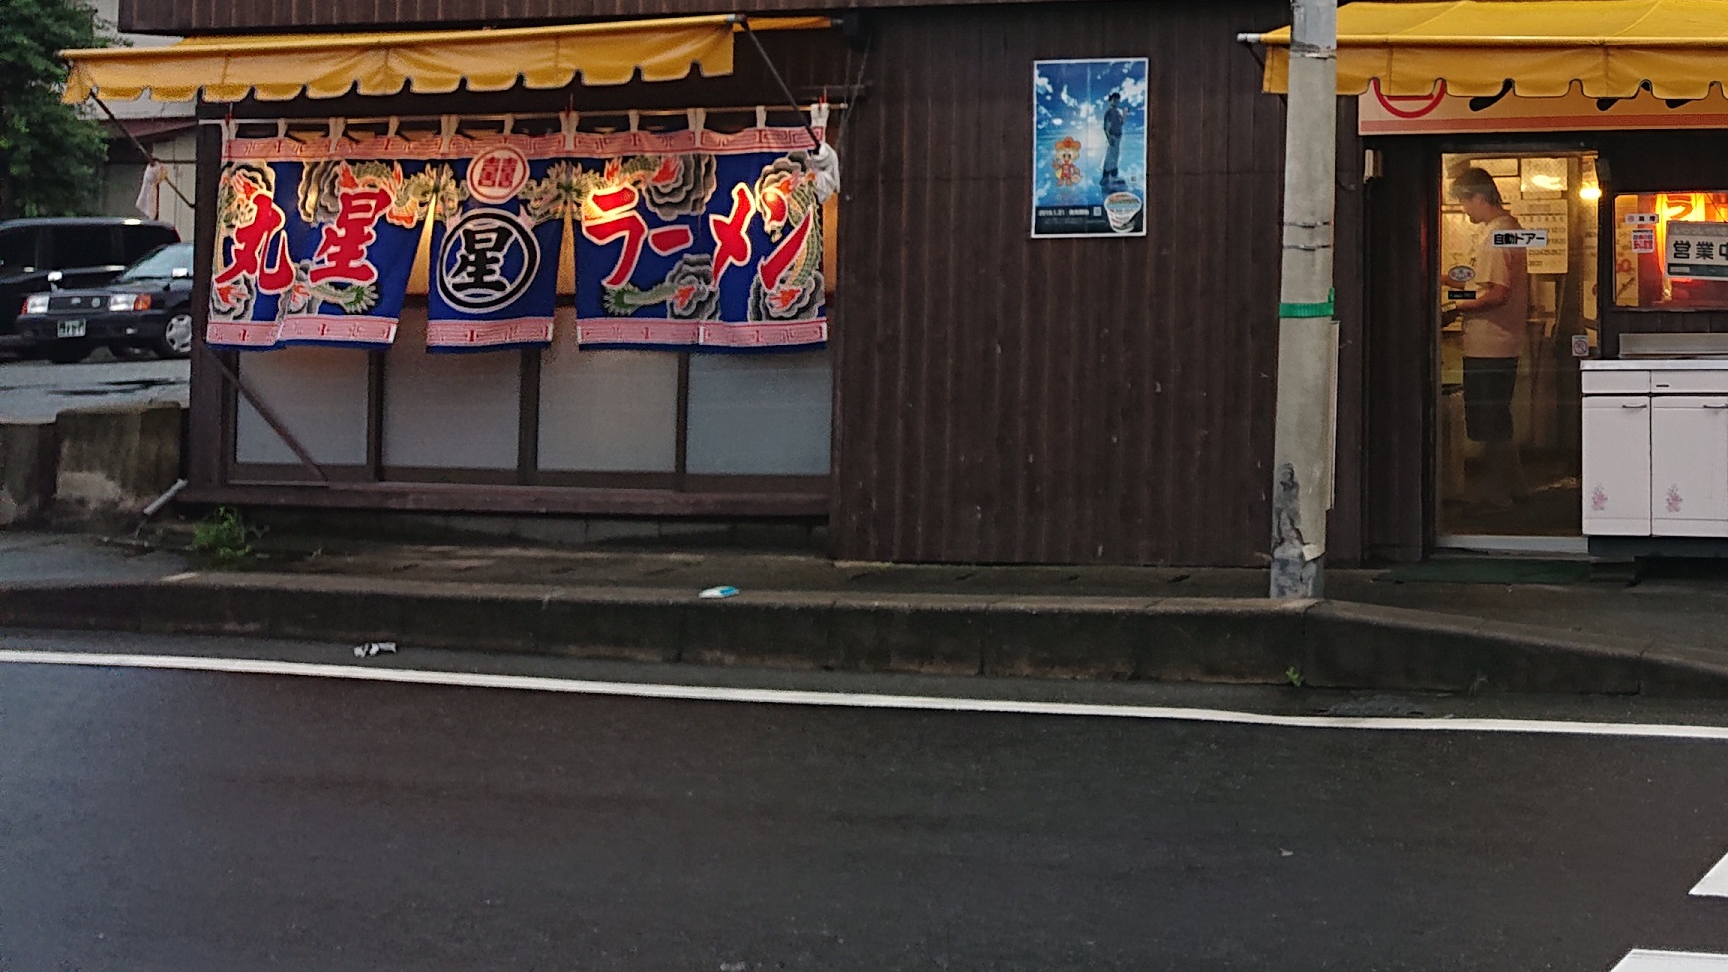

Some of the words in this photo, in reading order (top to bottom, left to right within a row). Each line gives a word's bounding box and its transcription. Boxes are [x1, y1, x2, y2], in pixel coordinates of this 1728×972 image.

[212, 187, 394, 293] 丸星
[584, 185, 814, 290] ラーメン
